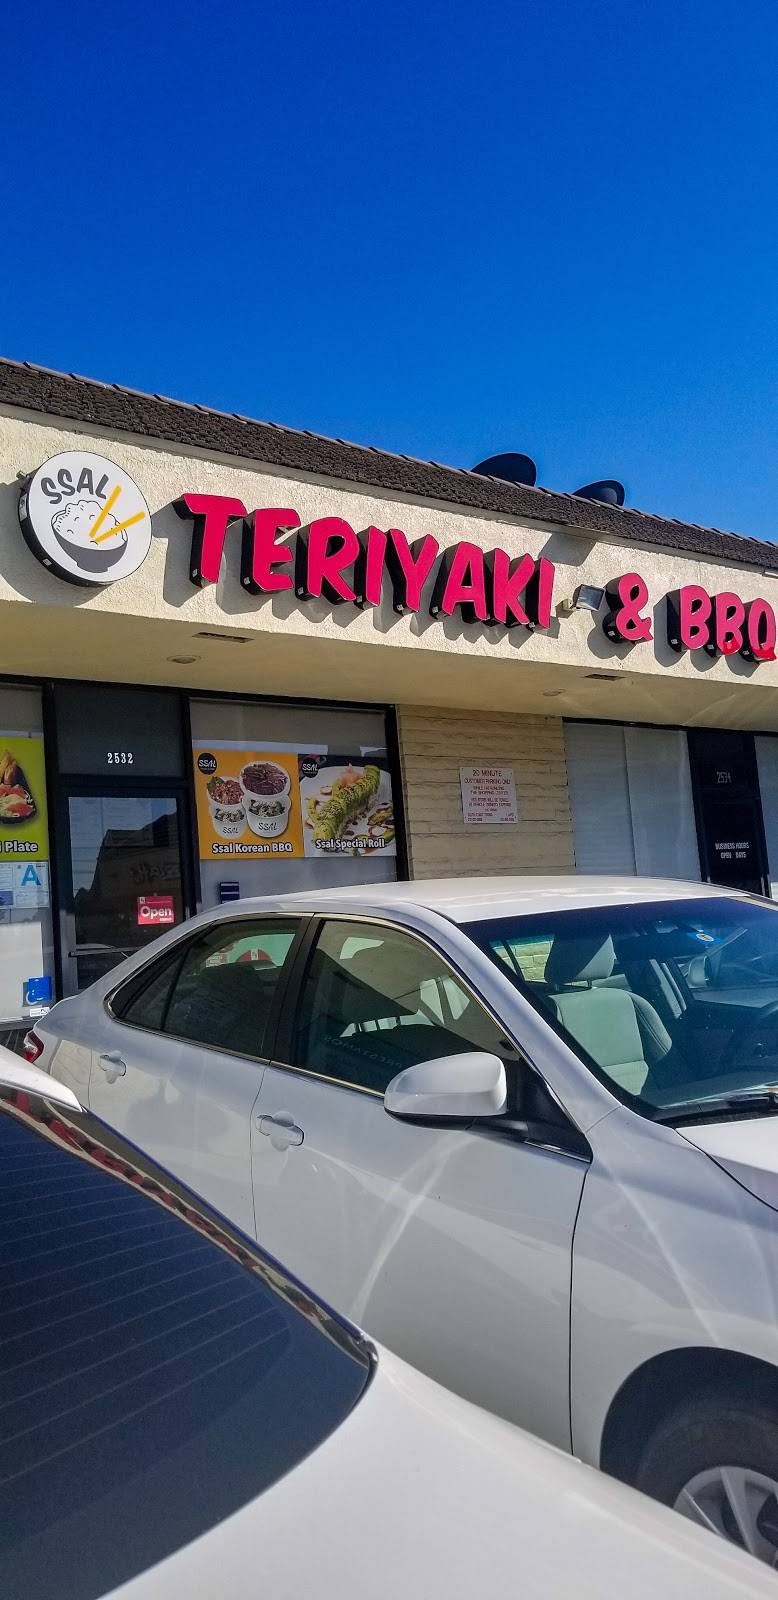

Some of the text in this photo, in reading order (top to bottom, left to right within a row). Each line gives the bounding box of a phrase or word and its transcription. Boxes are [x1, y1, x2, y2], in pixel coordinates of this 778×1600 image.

[40, 467, 109, 505] SSAL
[180, 492, 777, 662] TERIYAKI & BBQ
[107, 752, 134, 765] 2532
[481, 769, 503, 777] MINUTE
[5, 840, 38, 852] Plate
[212, 842, 294, 854] Ssal Korean BBQ
[315, 838, 385, 851] Ssal Special Roll
[20, 864, 42, 886] A
[140, 906, 172, 920] Open
